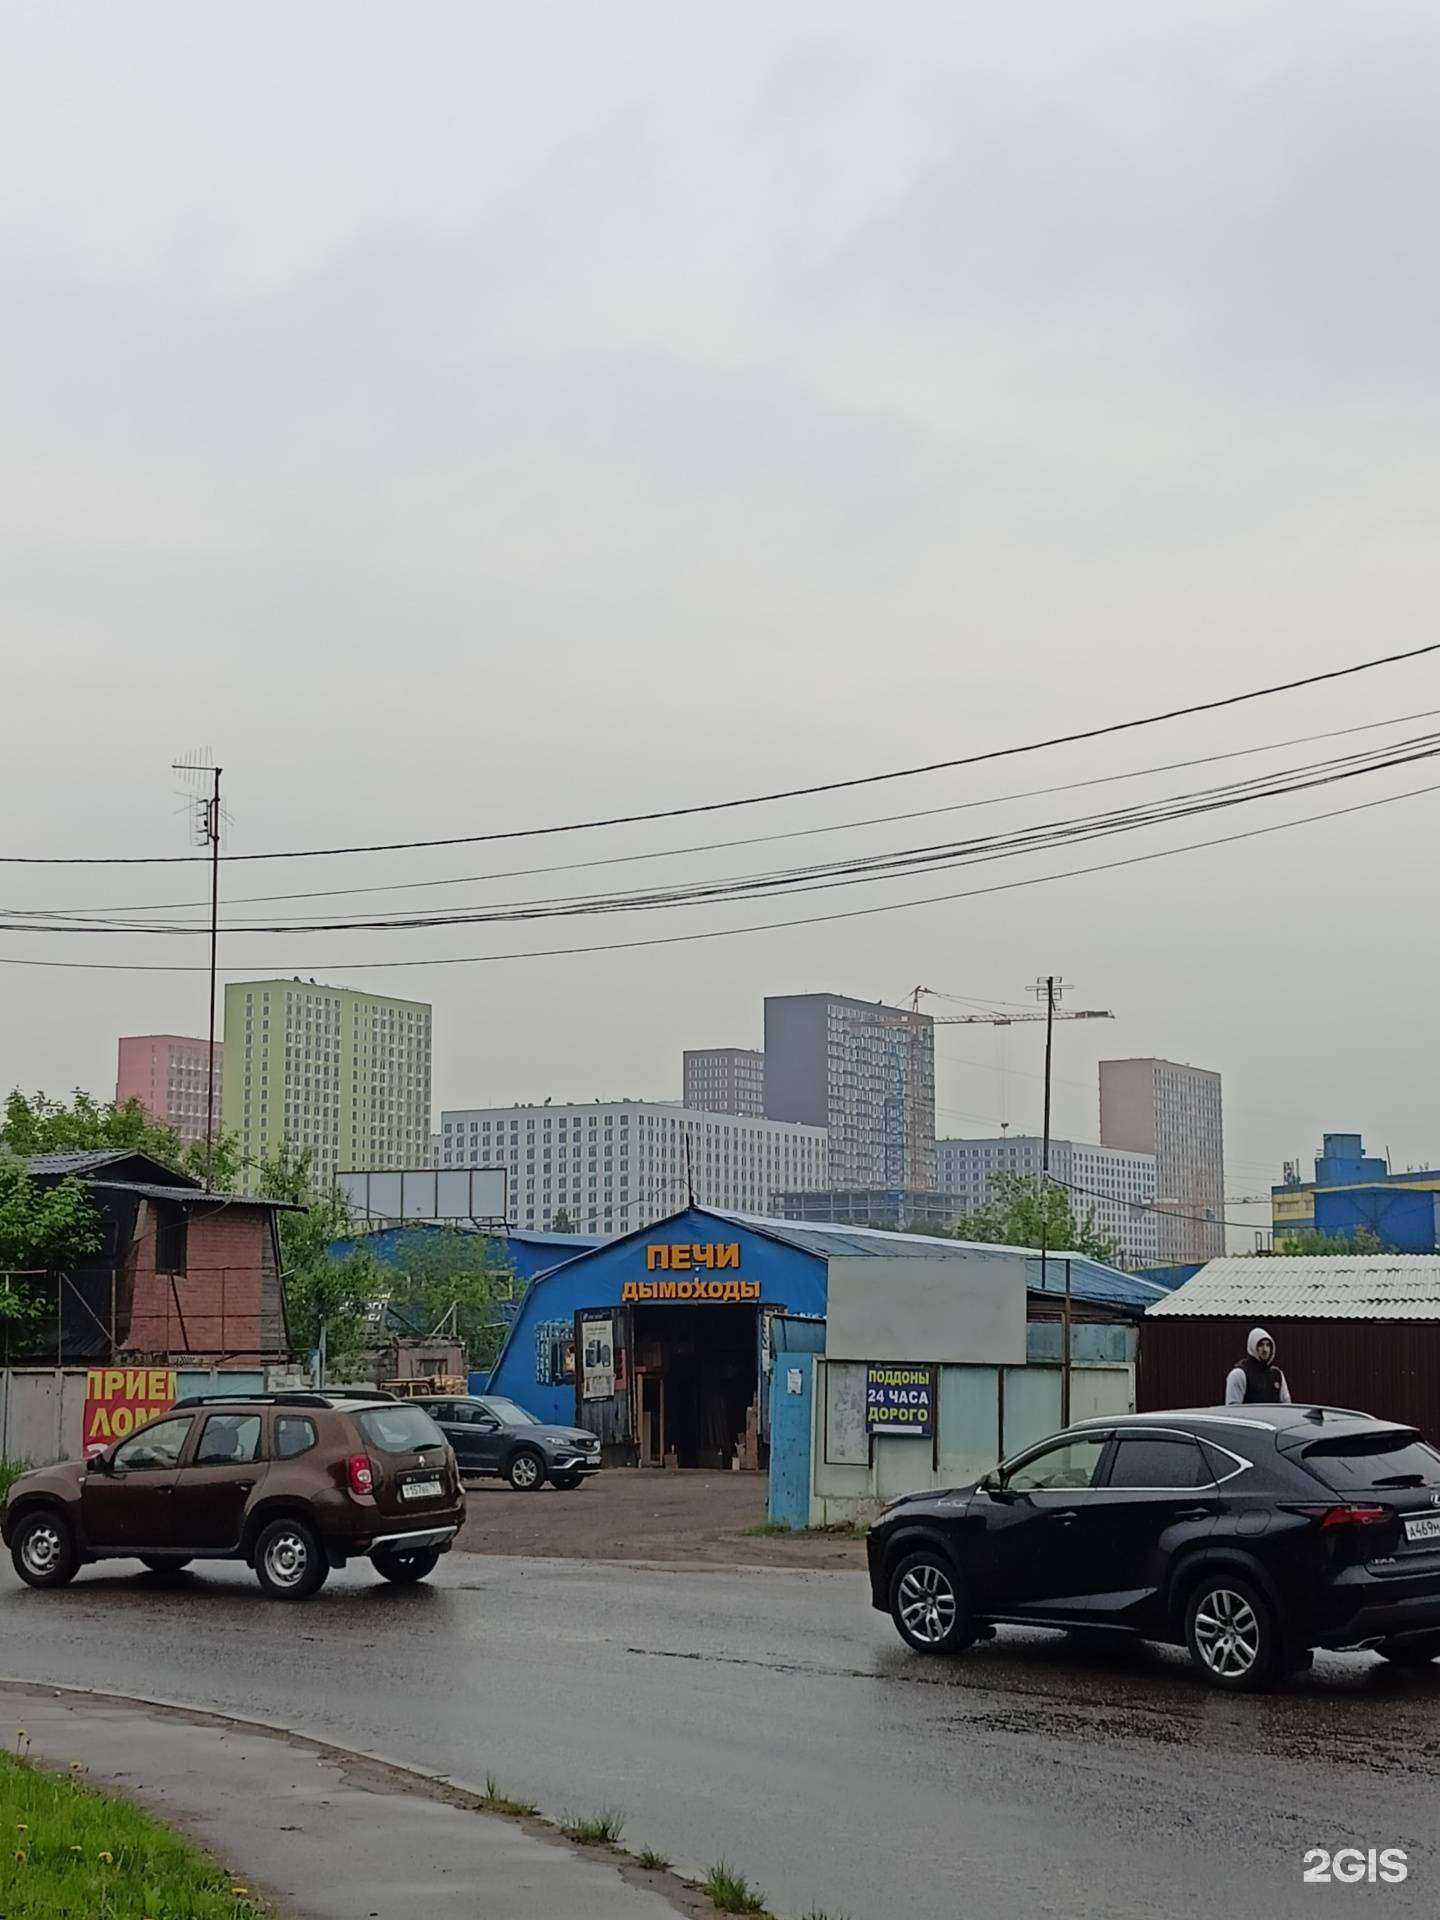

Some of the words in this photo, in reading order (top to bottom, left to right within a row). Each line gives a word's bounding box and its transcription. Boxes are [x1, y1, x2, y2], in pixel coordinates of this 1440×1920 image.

[647, 1243, 740, 1270] ПЕЧИ
[622, 1280, 761, 1302] ДЫМОХОДЫ
[868, 1370, 930, 1386] ПОДДОНЫ
[868, 1389, 885, 1403] 24
[888, 1390, 930, 1404] ЧАСА
[868, 1407, 929, 1422] ДОРОГО
